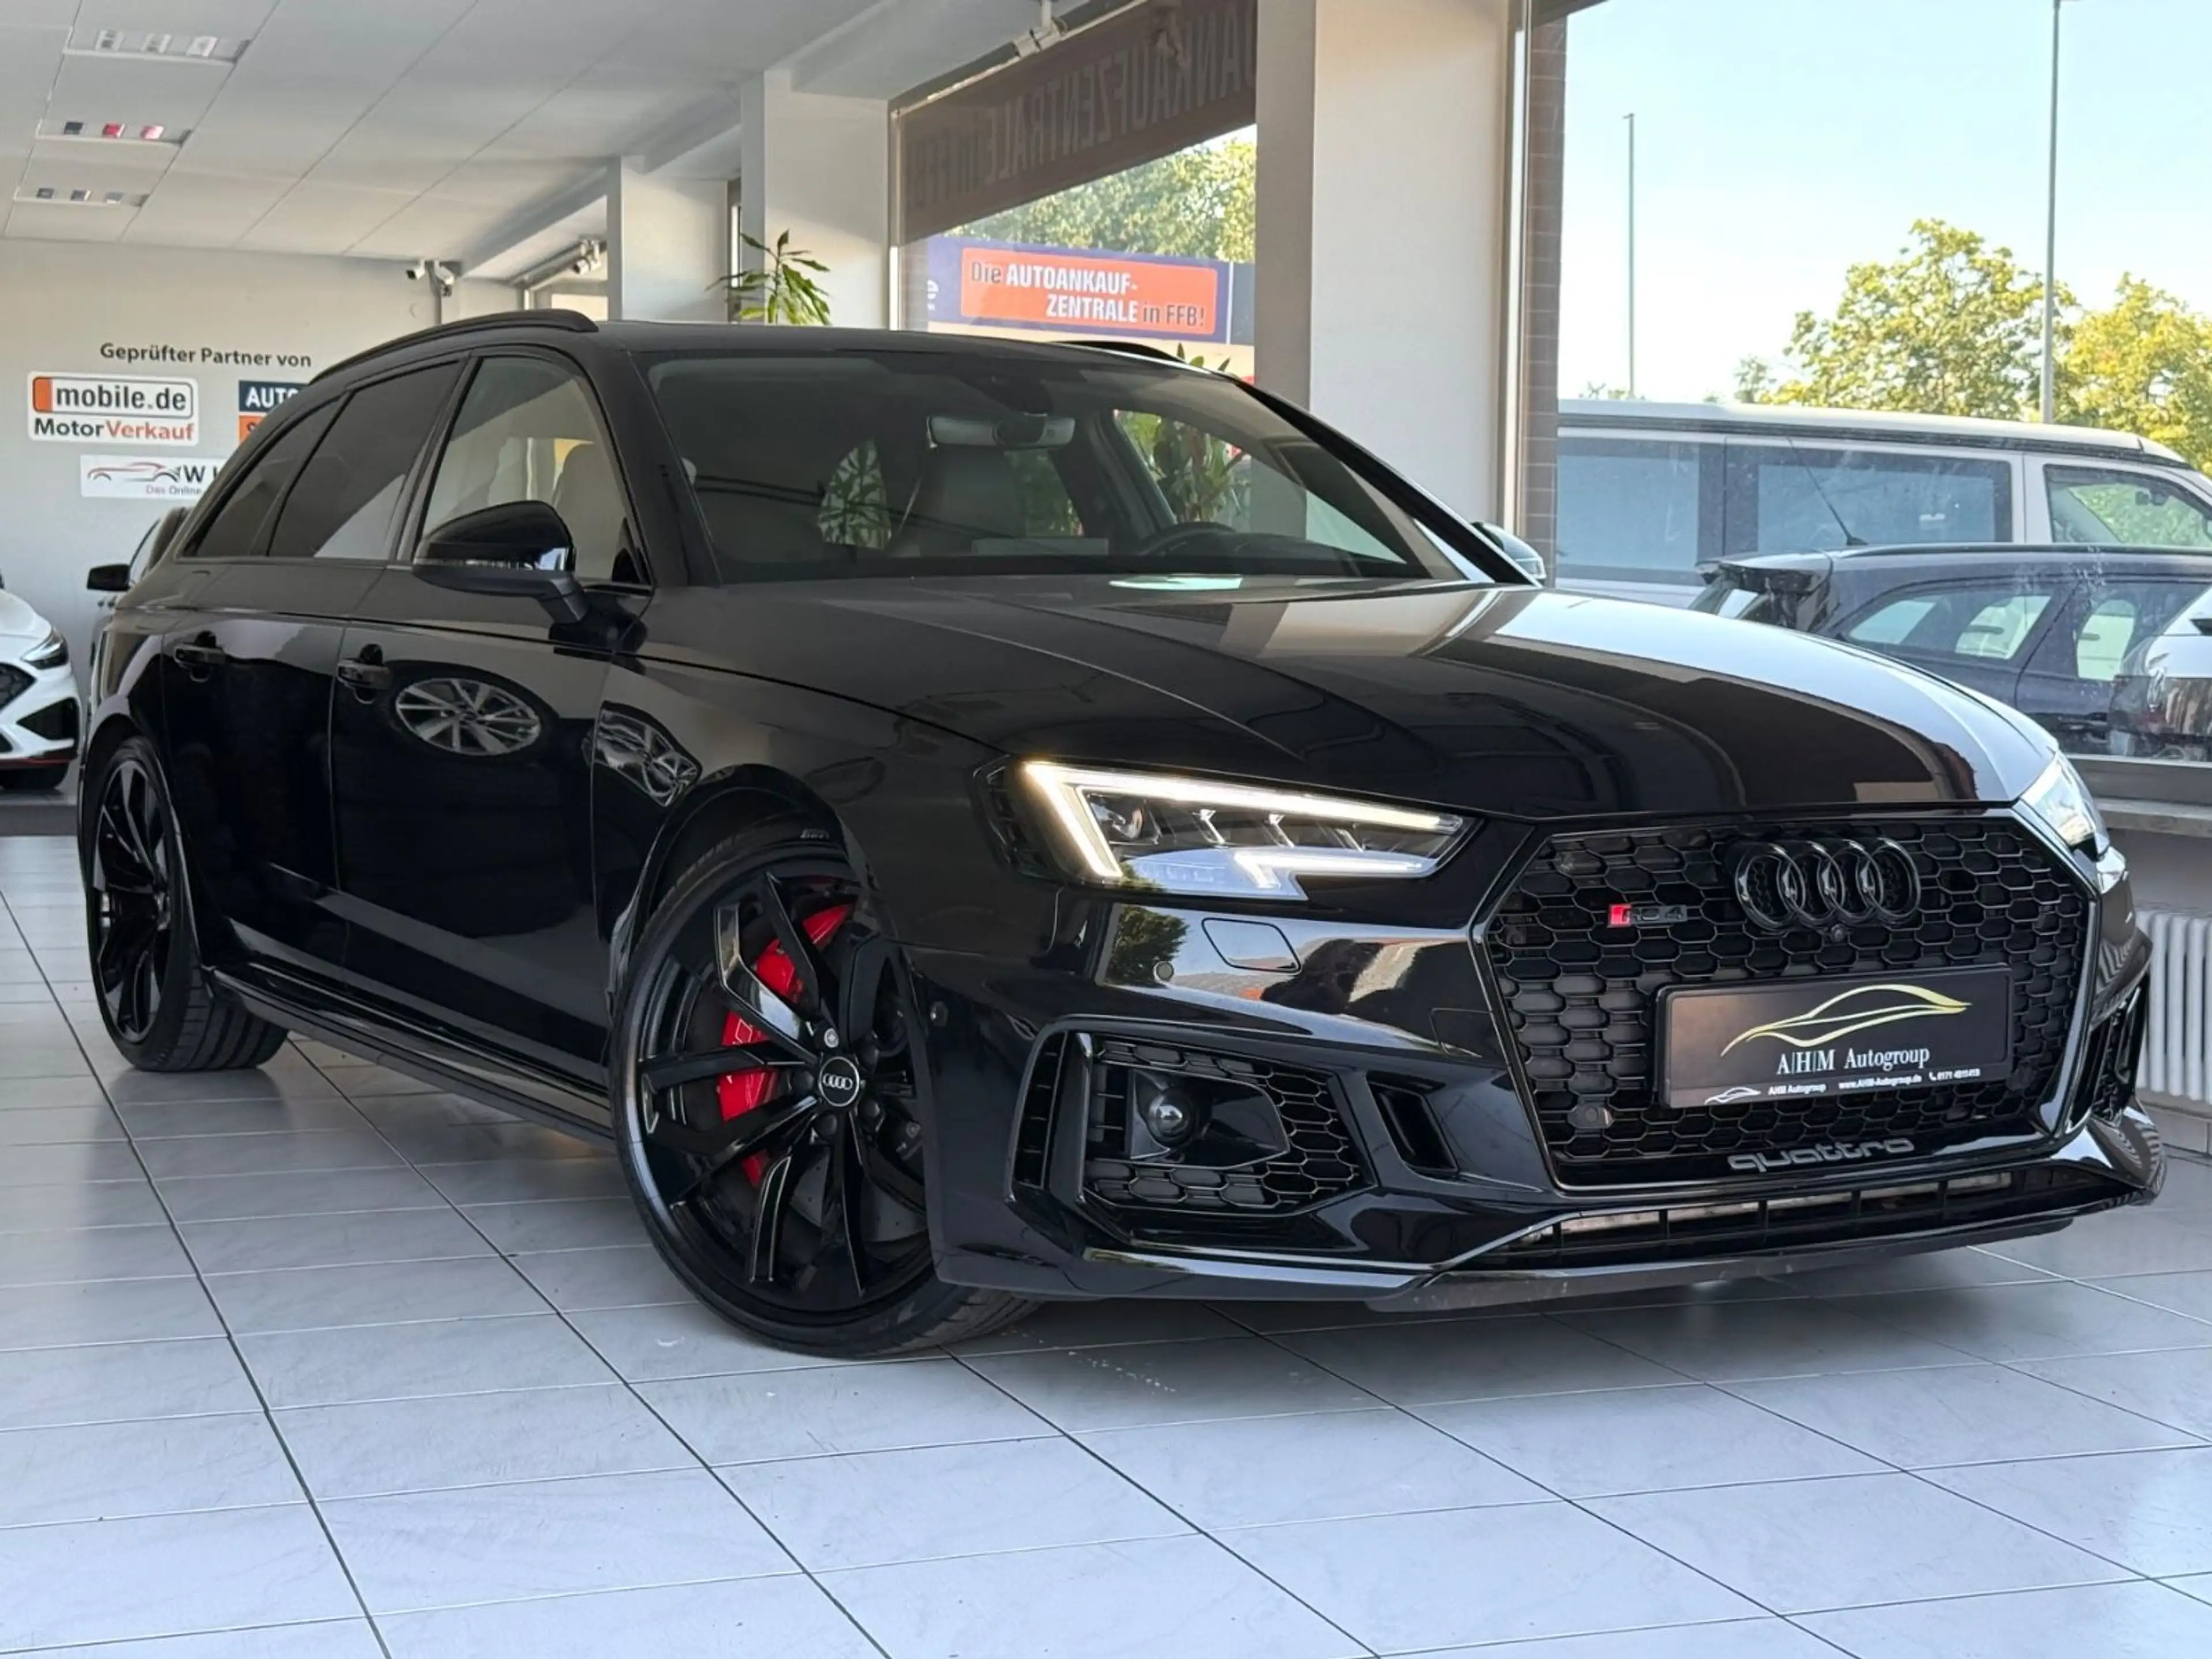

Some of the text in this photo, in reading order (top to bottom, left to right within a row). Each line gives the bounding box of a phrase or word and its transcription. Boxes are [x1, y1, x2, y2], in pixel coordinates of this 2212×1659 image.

[971, 261, 1138, 296] Die AUTOANKAUF-
[1046, 294, 1205, 327] ZENTRALE in FFB!
[100, 343, 312, 368] Geprüfter Partner von
[56, 386, 187, 411] mobile.de
[34, 418, 194, 441] MotorVerkauf
[1844, 1047, 1930, 1072] Autogroup
[1728, 1138, 1915, 1172] quattro
